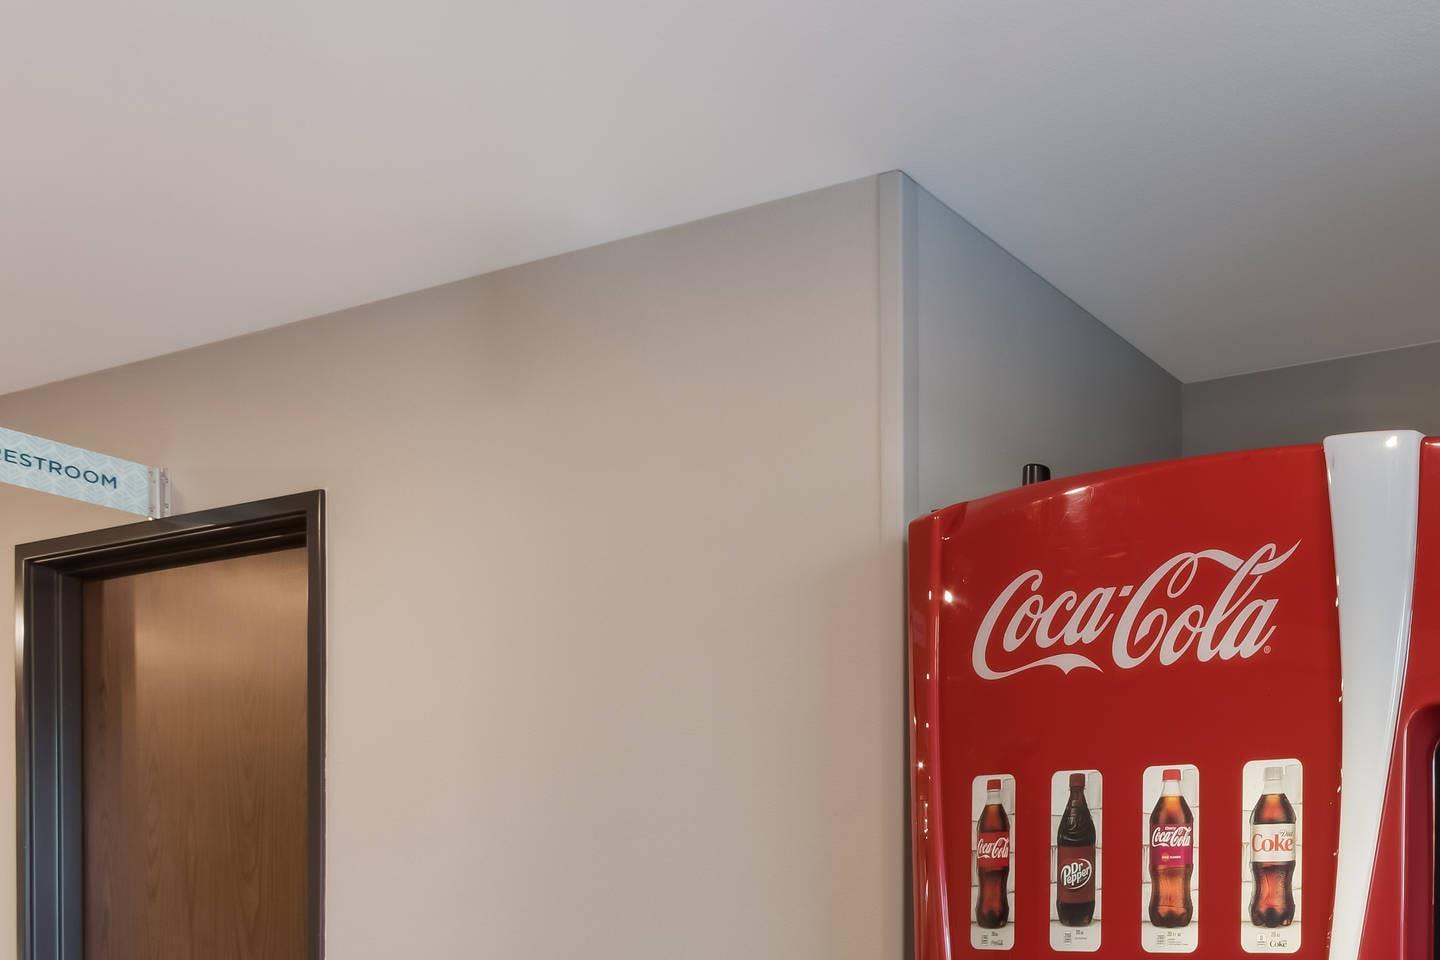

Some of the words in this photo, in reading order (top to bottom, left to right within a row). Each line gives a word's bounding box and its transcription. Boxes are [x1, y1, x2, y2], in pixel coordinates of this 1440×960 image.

[0, 447, 117, 490] ESTROOM
[972, 537, 1303, 681] Coca-Cola
[1152, 827, 1191, 847] Coca-Cola
[1252, 834, 1294, 852] Coke
[977, 838, 1009, 859] Coca-Cola
[1063, 866, 1090, 886] Pepper
[1071, 862, 1084, 876] Dr
